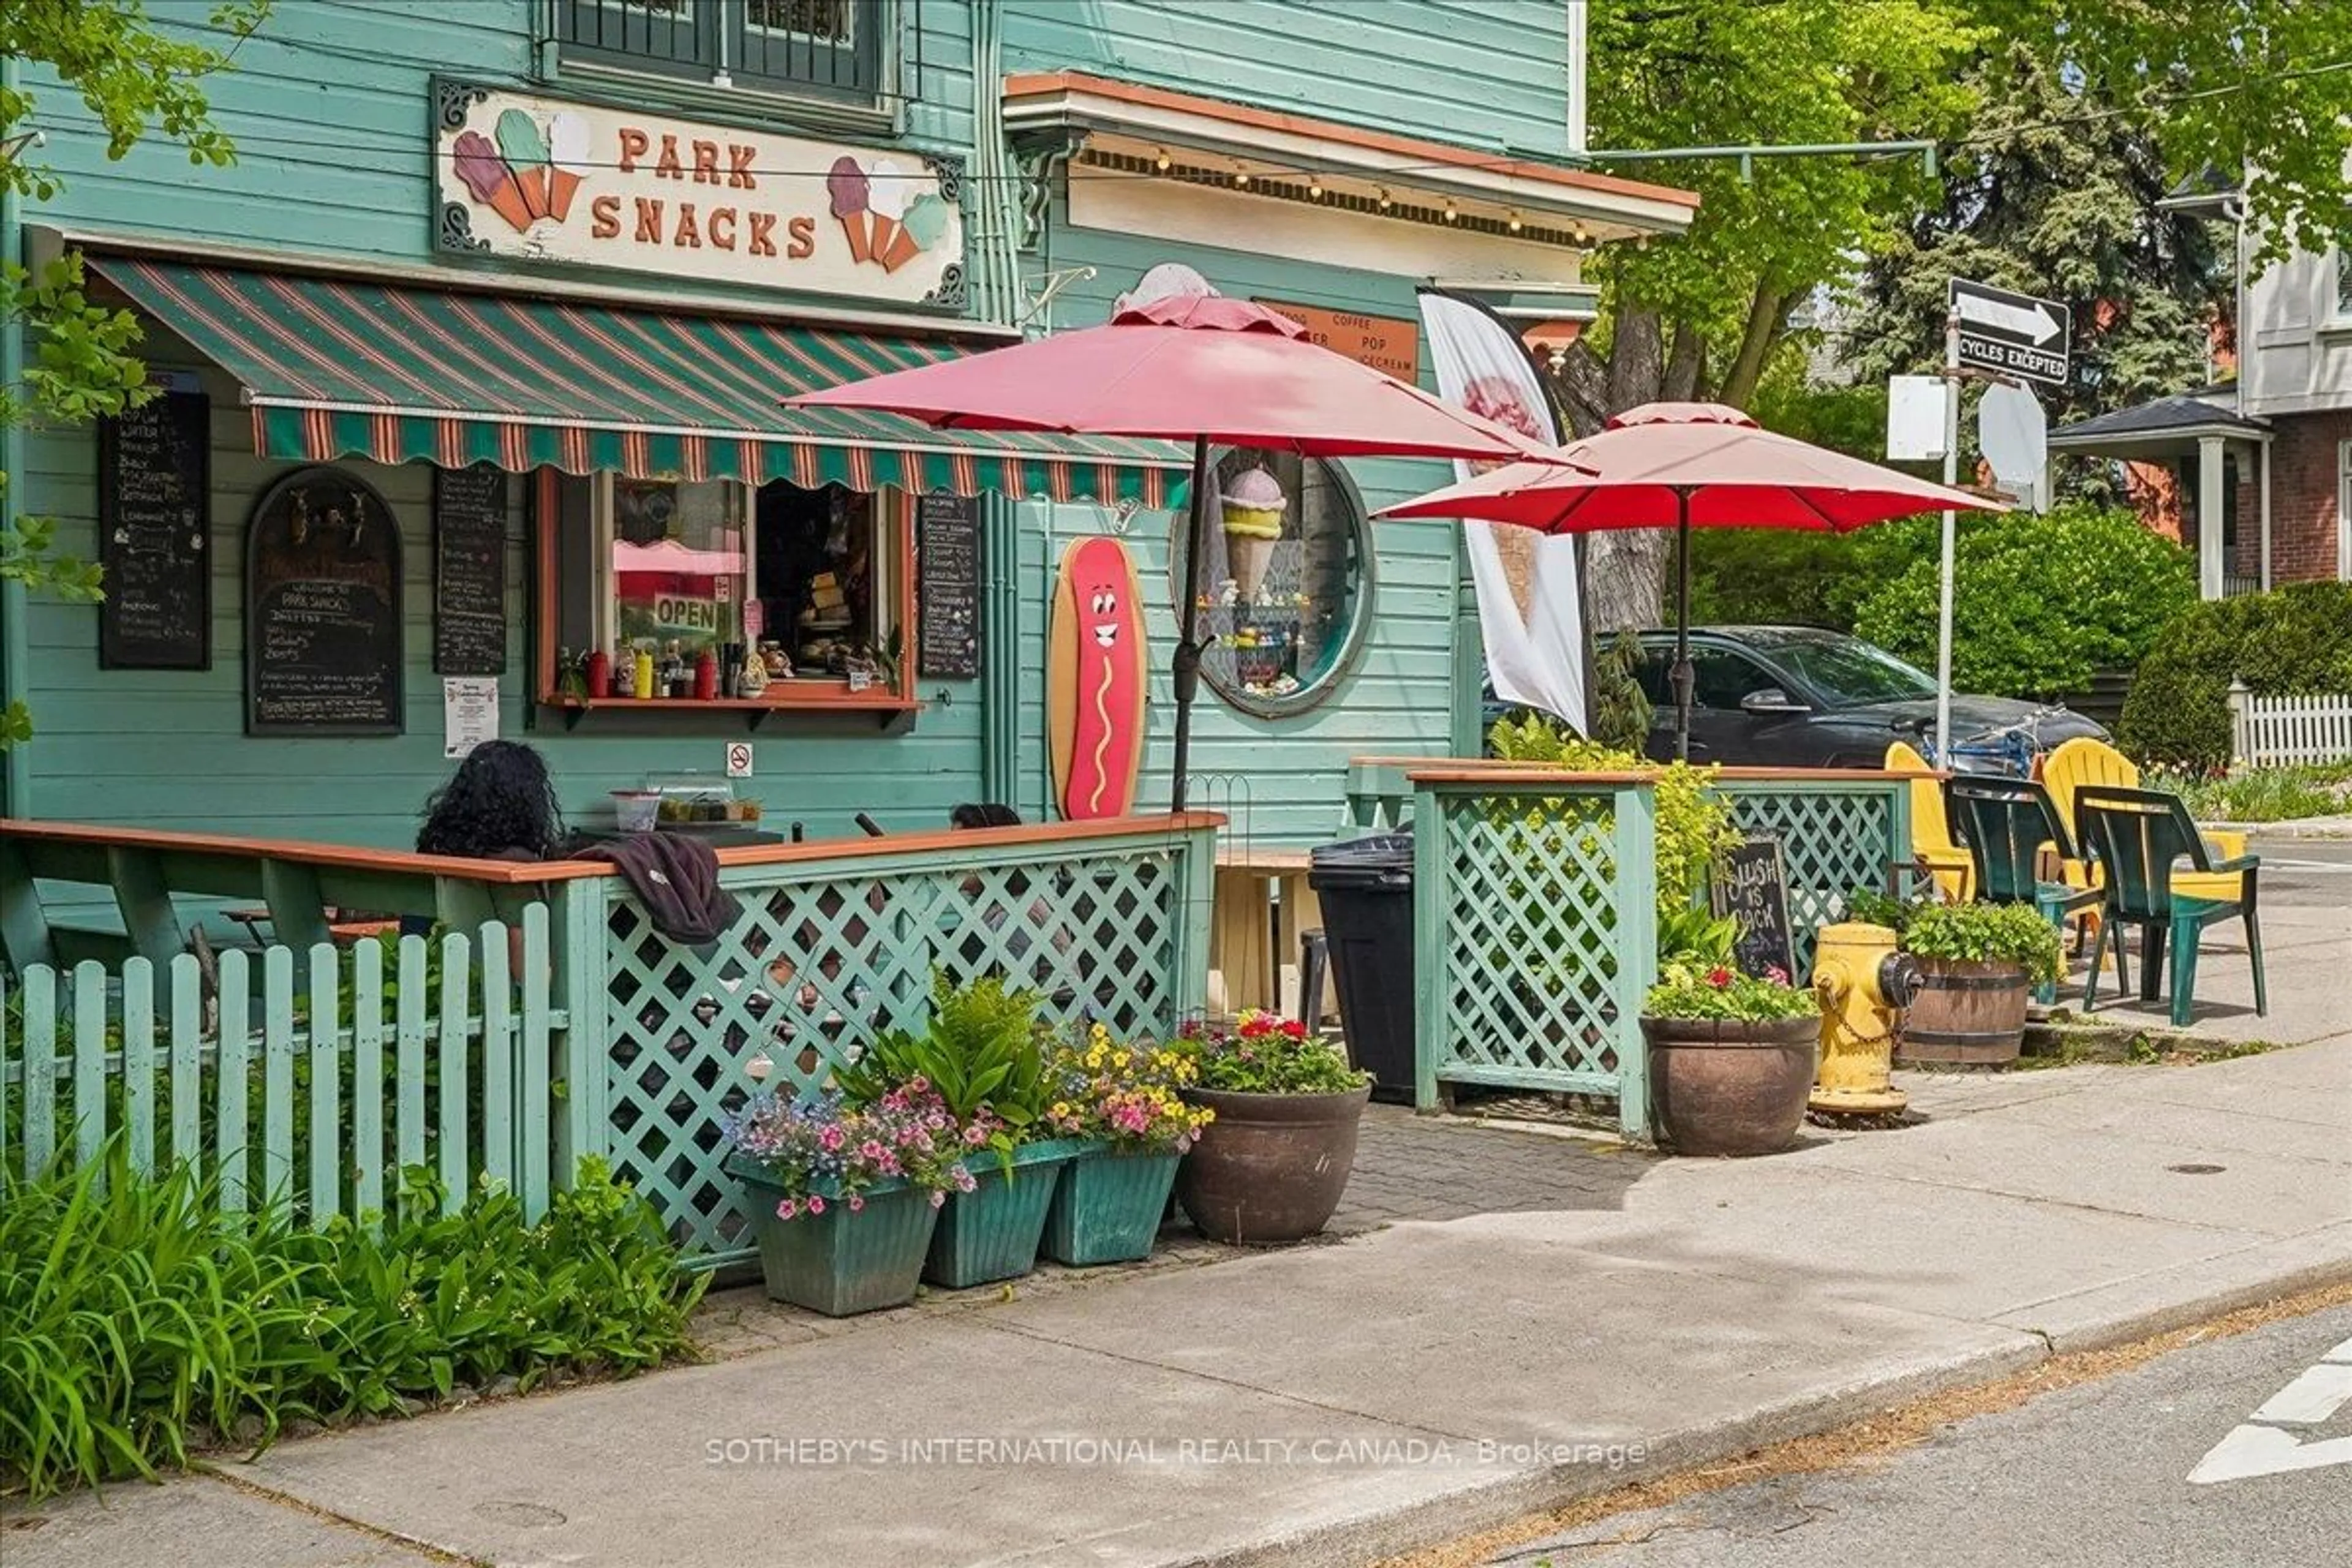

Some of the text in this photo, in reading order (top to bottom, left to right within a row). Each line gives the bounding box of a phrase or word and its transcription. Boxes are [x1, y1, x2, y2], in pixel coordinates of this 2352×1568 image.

[618, 127, 757, 190] PARK
[591, 195, 816, 260] SNACKS
[1332, 314, 1371, 330] COFFEE
[1362, 336, 1386, 350] POP
[1960, 338, 2066, 377] CYCLES EXCEPTED
[657, 597, 715, 629] OPEN
[1725, 856, 1779, 902] SLUSH
[1747, 886, 1764, 908] IS
